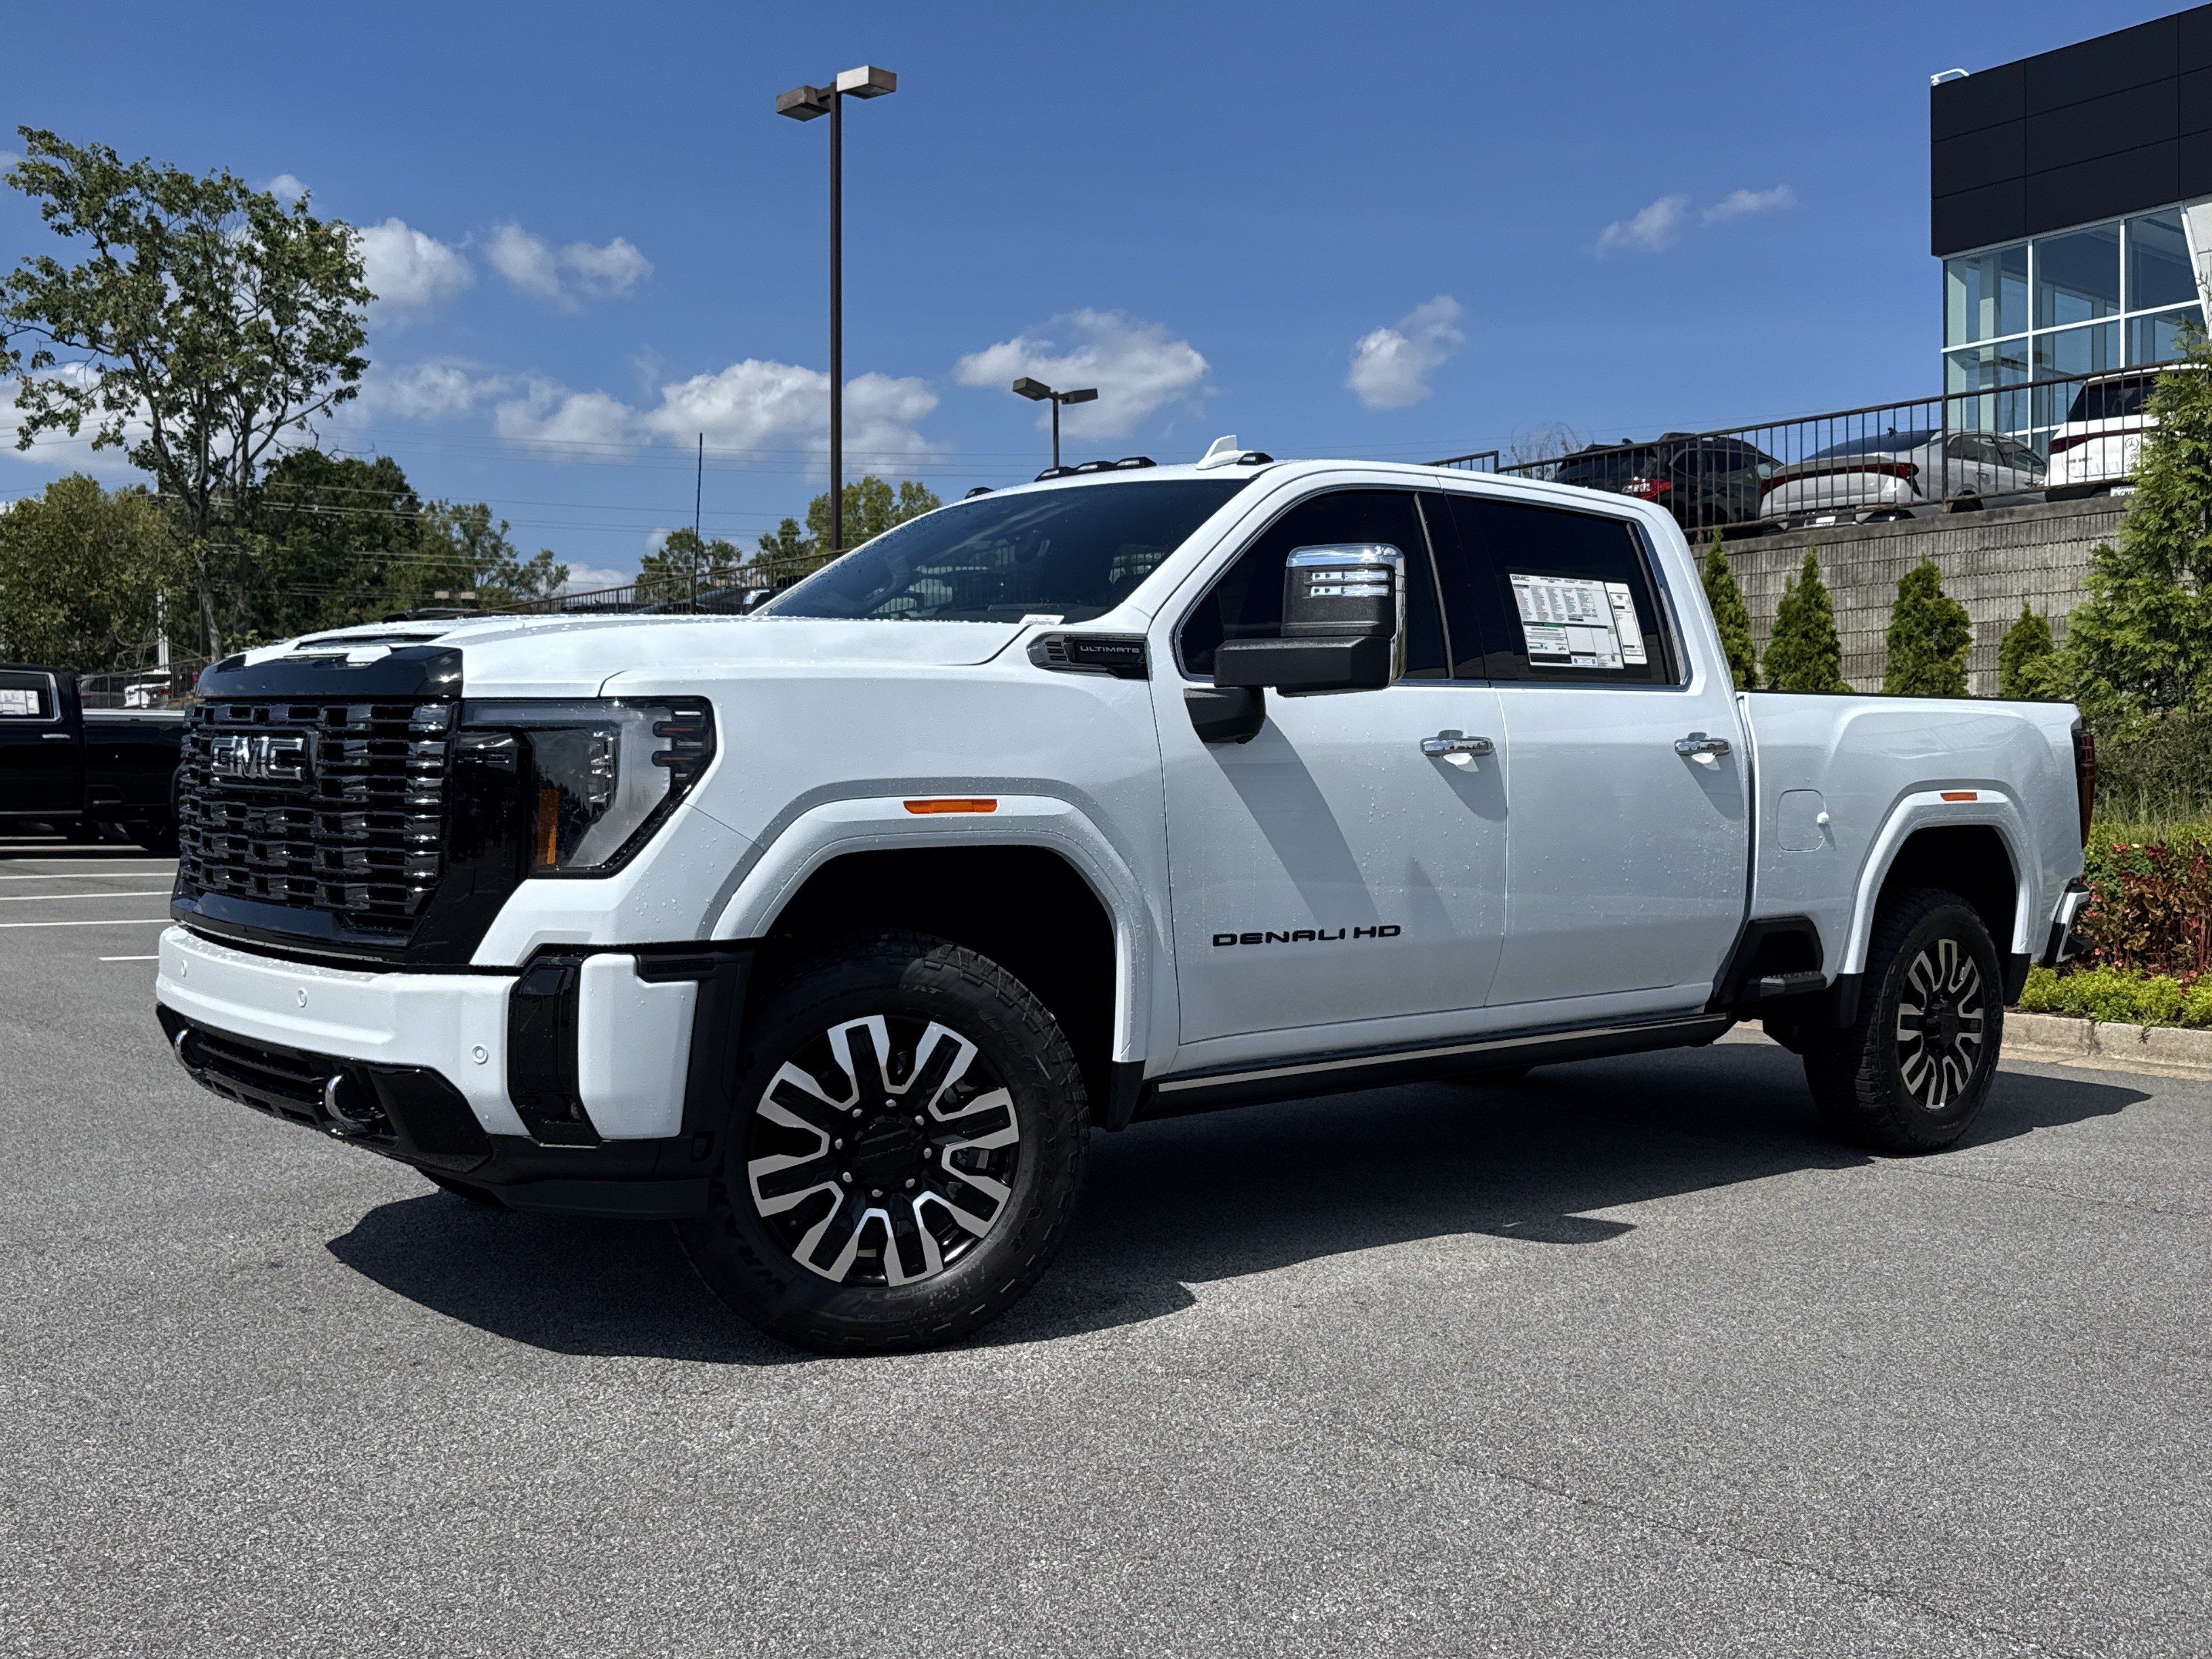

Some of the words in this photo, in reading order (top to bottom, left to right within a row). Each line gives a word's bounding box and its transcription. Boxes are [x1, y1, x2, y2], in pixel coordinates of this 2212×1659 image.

[1080, 645, 1141, 653] ULTIMATE
[211, 736, 304, 781] GMC
[1212, 928, 1346, 947] DENALI
[1353, 925, 1401, 939] HD
